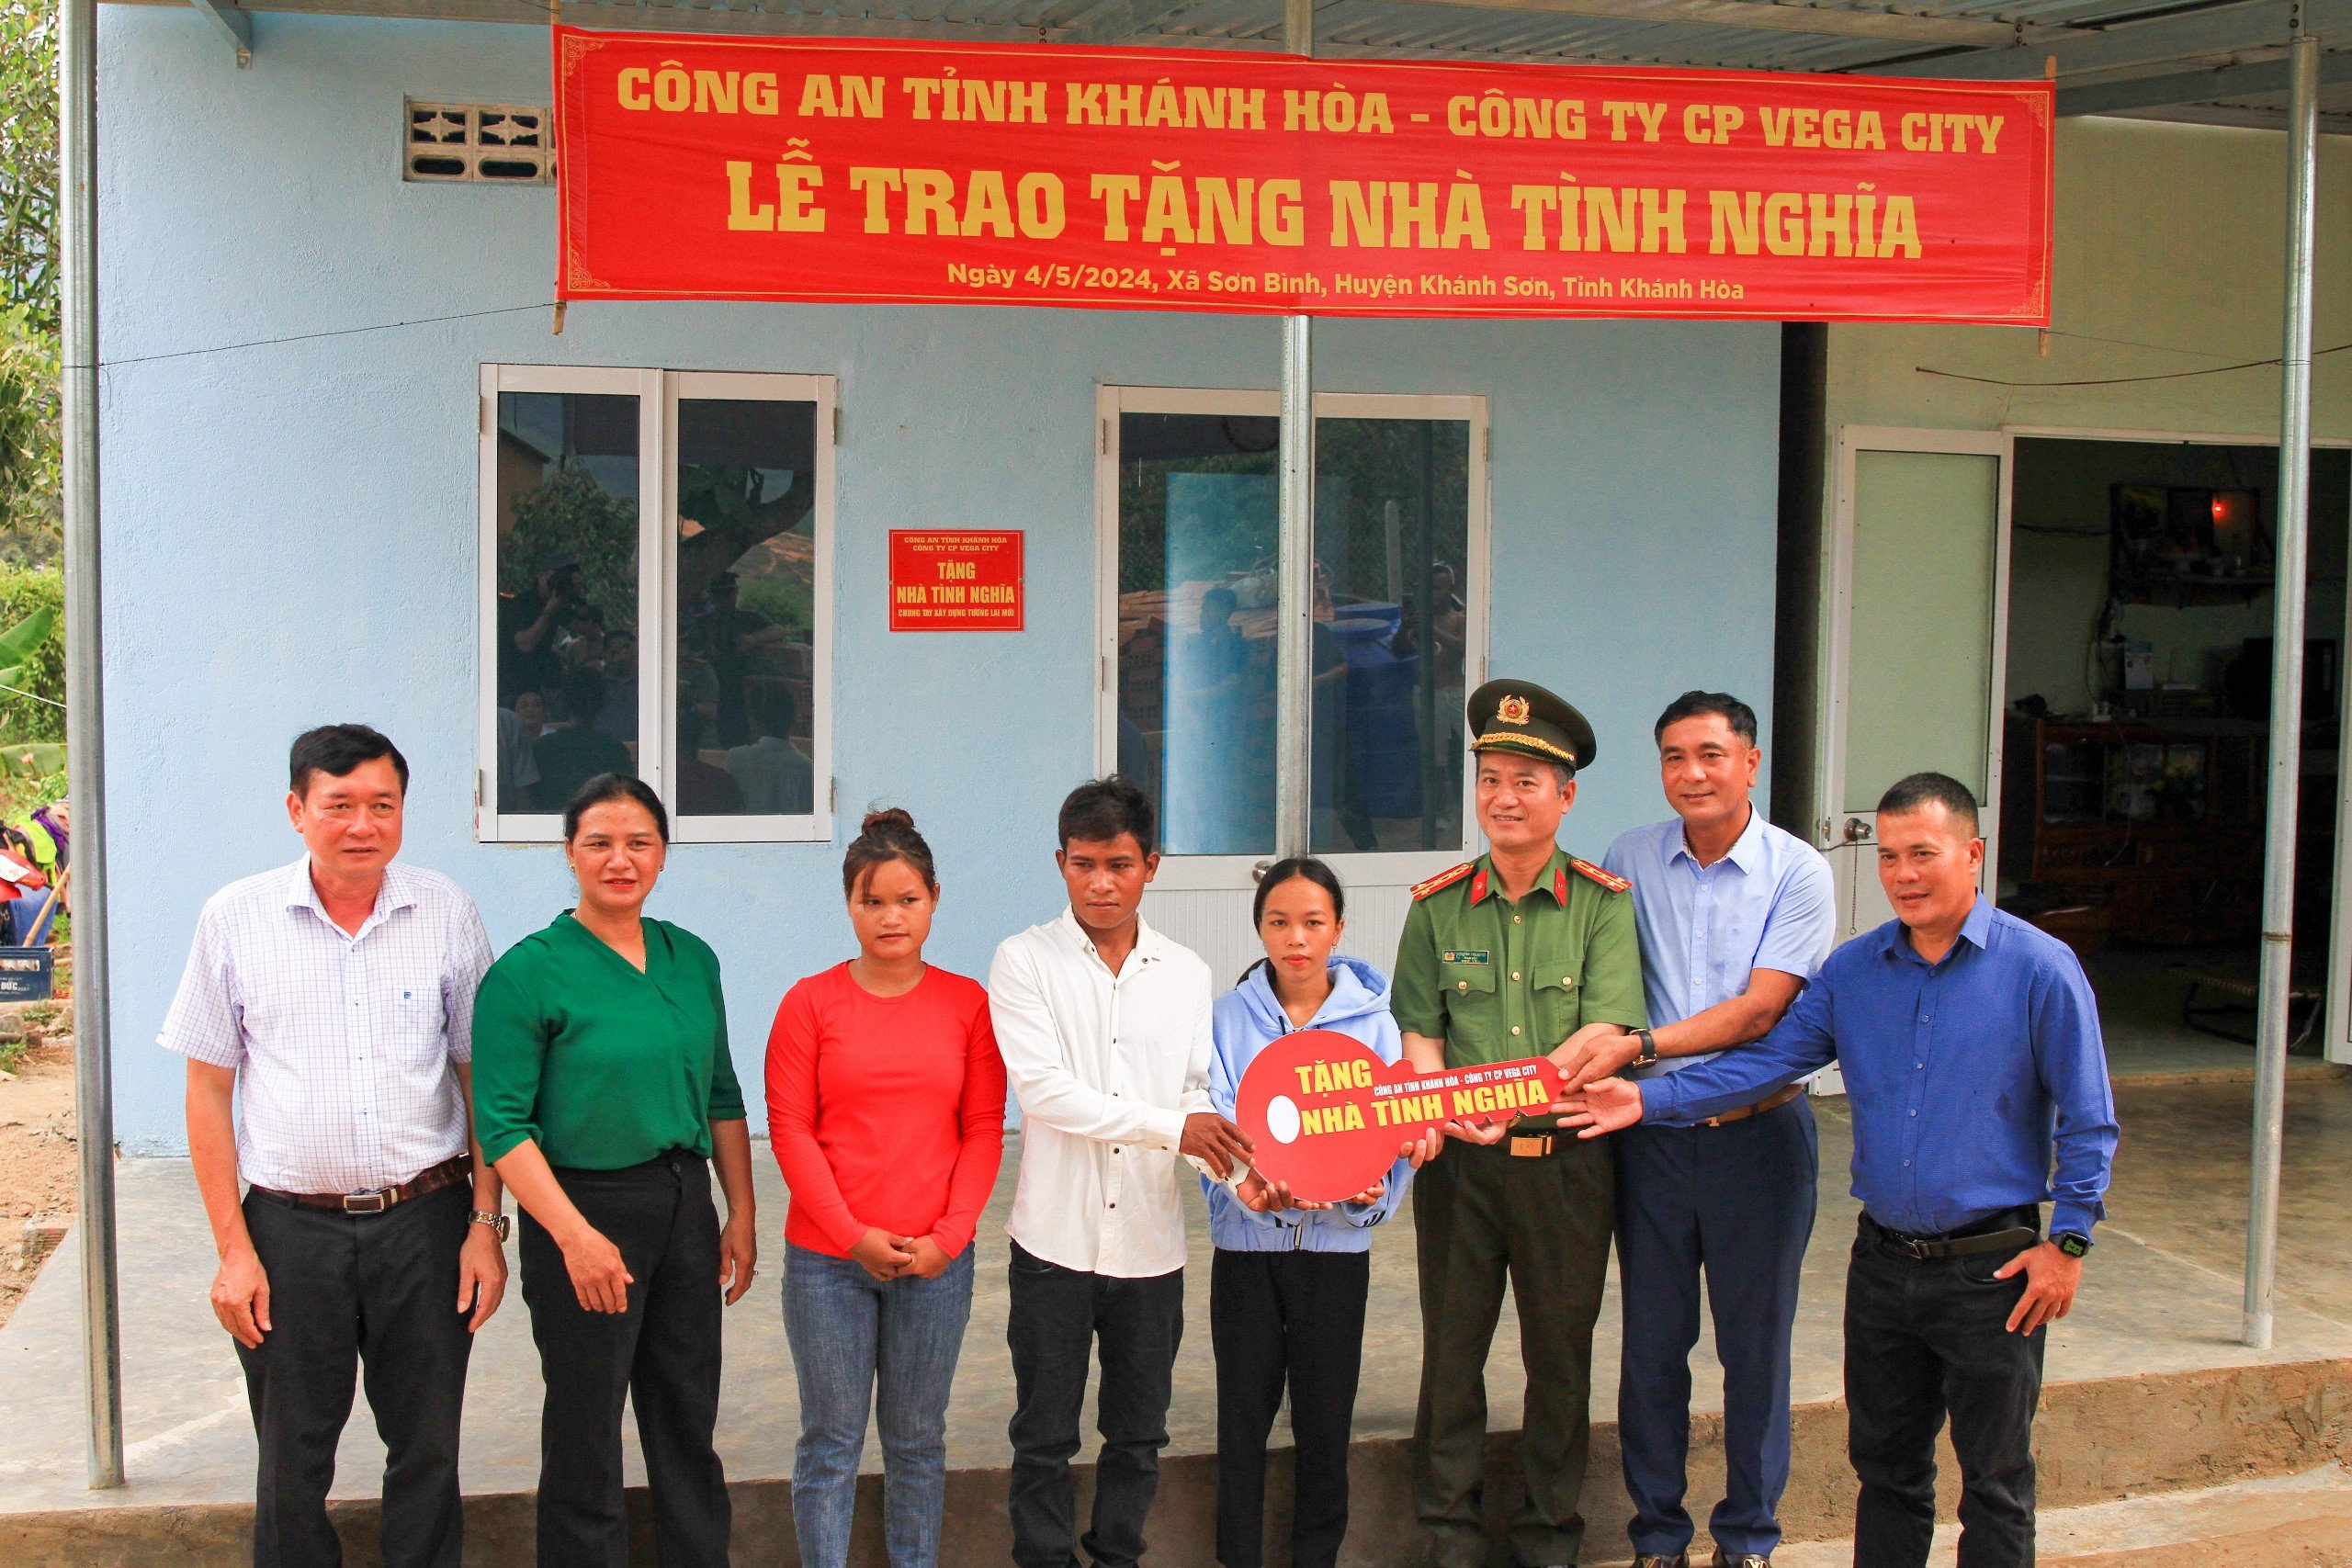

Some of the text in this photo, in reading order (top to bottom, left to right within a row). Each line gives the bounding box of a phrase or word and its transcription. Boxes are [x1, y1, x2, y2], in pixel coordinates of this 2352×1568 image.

[617, 59, 2005, 154] CÔNG AN TỈNH KHÁNH HÒA - CÔNG TY CP VEGA CITY
[726, 137, 1923, 259] LỄ TRAO TẶNG NHÀ TÌNH NGHĨA
[947, 263, 1744, 301] Ngày 4/5/2024, Xã Sơn Bình, Huyện Khánh Sơn, Tỉnh Khánh Hòa
[937, 559, 976, 582] TẶNG
[897, 583, 1015, 604] NHÀ TÌNH NGHĨA
[898, 608, 921, 616] CHUNG
[1294, 1058, 1374, 1098] TẶNG
[1394, 1083, 1403, 1094] AN
[1483, 1070, 1493, 1081] TY
[1493, 1069, 1503, 1080] CP
[1503, 1066, 1521, 1078] VEGA
[1521, 1064, 1537, 1076] CITY
[1300, 1077, 1550, 1136] NHÀ TÌNH NGHĨA
